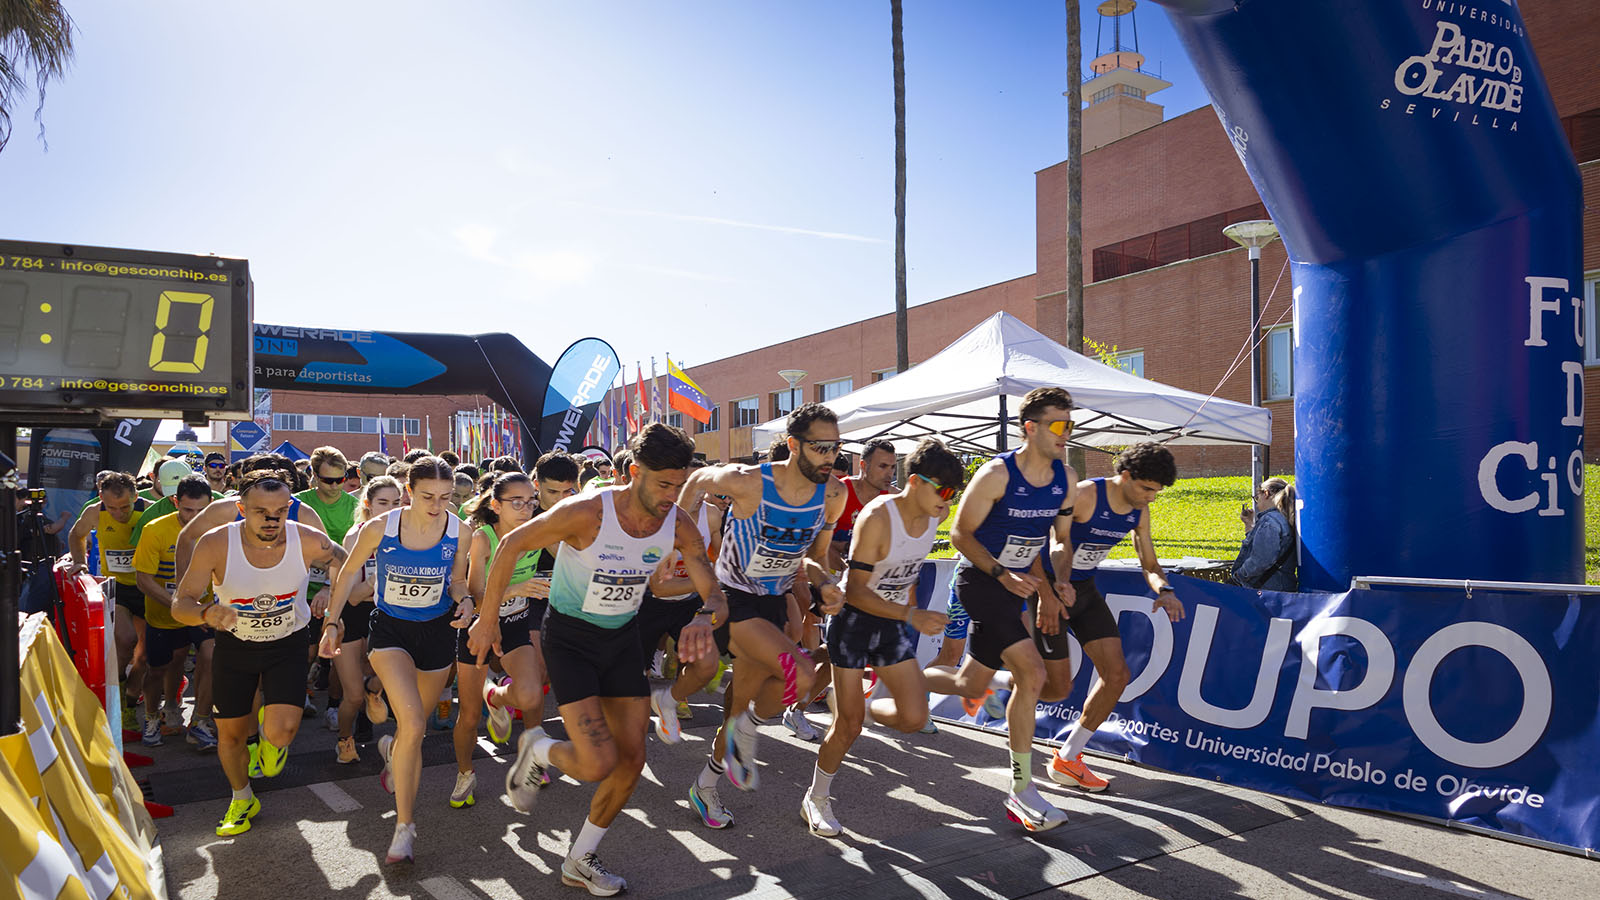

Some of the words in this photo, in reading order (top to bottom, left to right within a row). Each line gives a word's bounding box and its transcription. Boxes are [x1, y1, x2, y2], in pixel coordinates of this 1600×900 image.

[1422, 0, 1524, 37] UNIVERSIDAD
[1429, 20, 1514, 75] PABLO
[1394, 55, 1524, 113] OLAVIDE
[1380, 98, 1518, 132] SEVILLA
[11, 256, 44, 269] 784
[61, 260, 228, 282] info@gesconchip.es
[254, 324, 373, 343] WERADE
[266, 367, 296, 378] para
[299, 368, 372, 383] deportistas
[11, 377, 44, 388] 784
[61, 378, 228, 394] info@gesconchip.es
[41, 448, 100, 462] POWERADE
[1015, 546, 1032, 558] 81
[762, 558, 793, 569] 350
[399, 584, 431, 597] 167
[601, 586, 634, 601] 228
[250, 615, 283, 629] 268
[505, 609, 530, 624] NIKE
[1067, 593, 1553, 769] DUPO
[1035, 703, 1081, 721] ervicio
[1107, 711, 1179, 744] Deportes
[1185, 728, 1311, 772] Universidad
[1312, 754, 1387, 785] Pablo
[1394, 769, 1428, 793] de
[1435, 774, 1545, 808] Olavide
